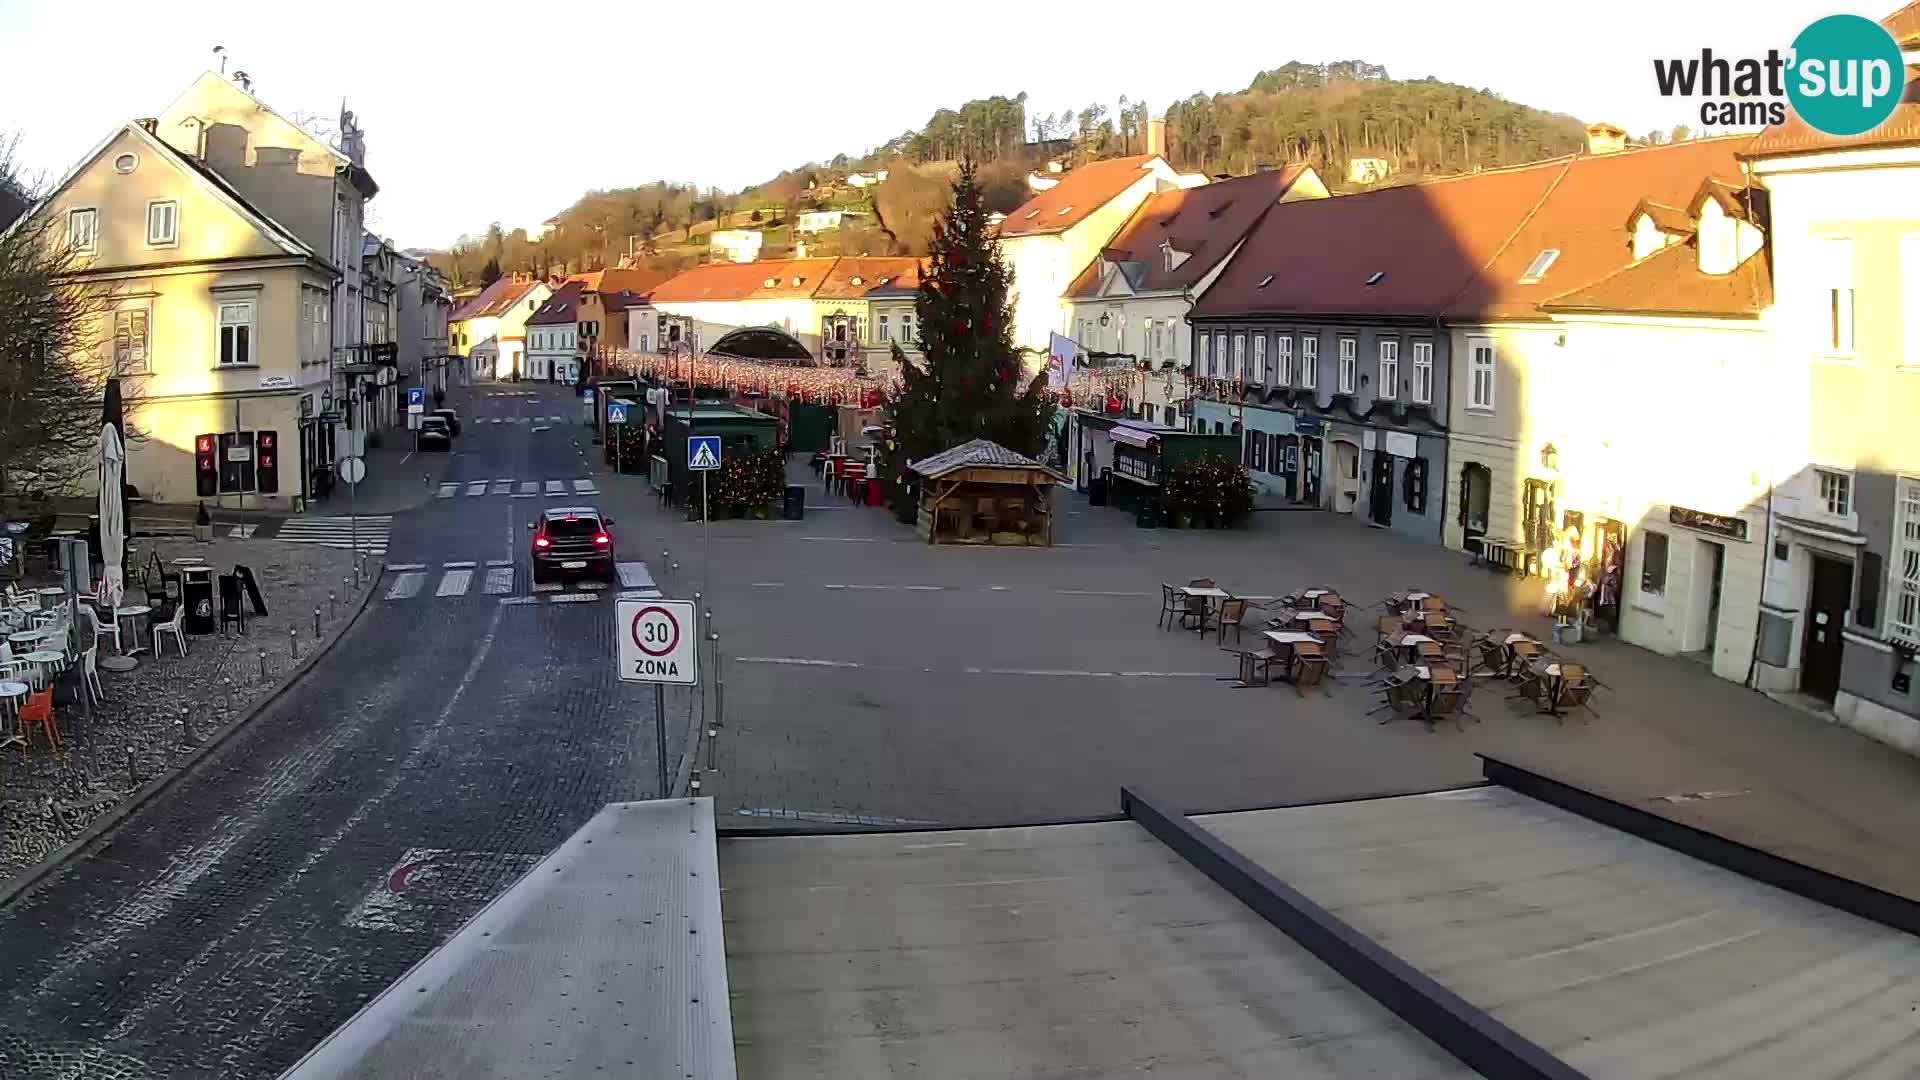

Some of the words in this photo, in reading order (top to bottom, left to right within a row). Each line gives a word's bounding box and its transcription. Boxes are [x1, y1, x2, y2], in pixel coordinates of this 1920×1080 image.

[412, 392, 420, 402] P
[644, 622, 668, 643] 30
[635, 660, 679, 676] ZONA
